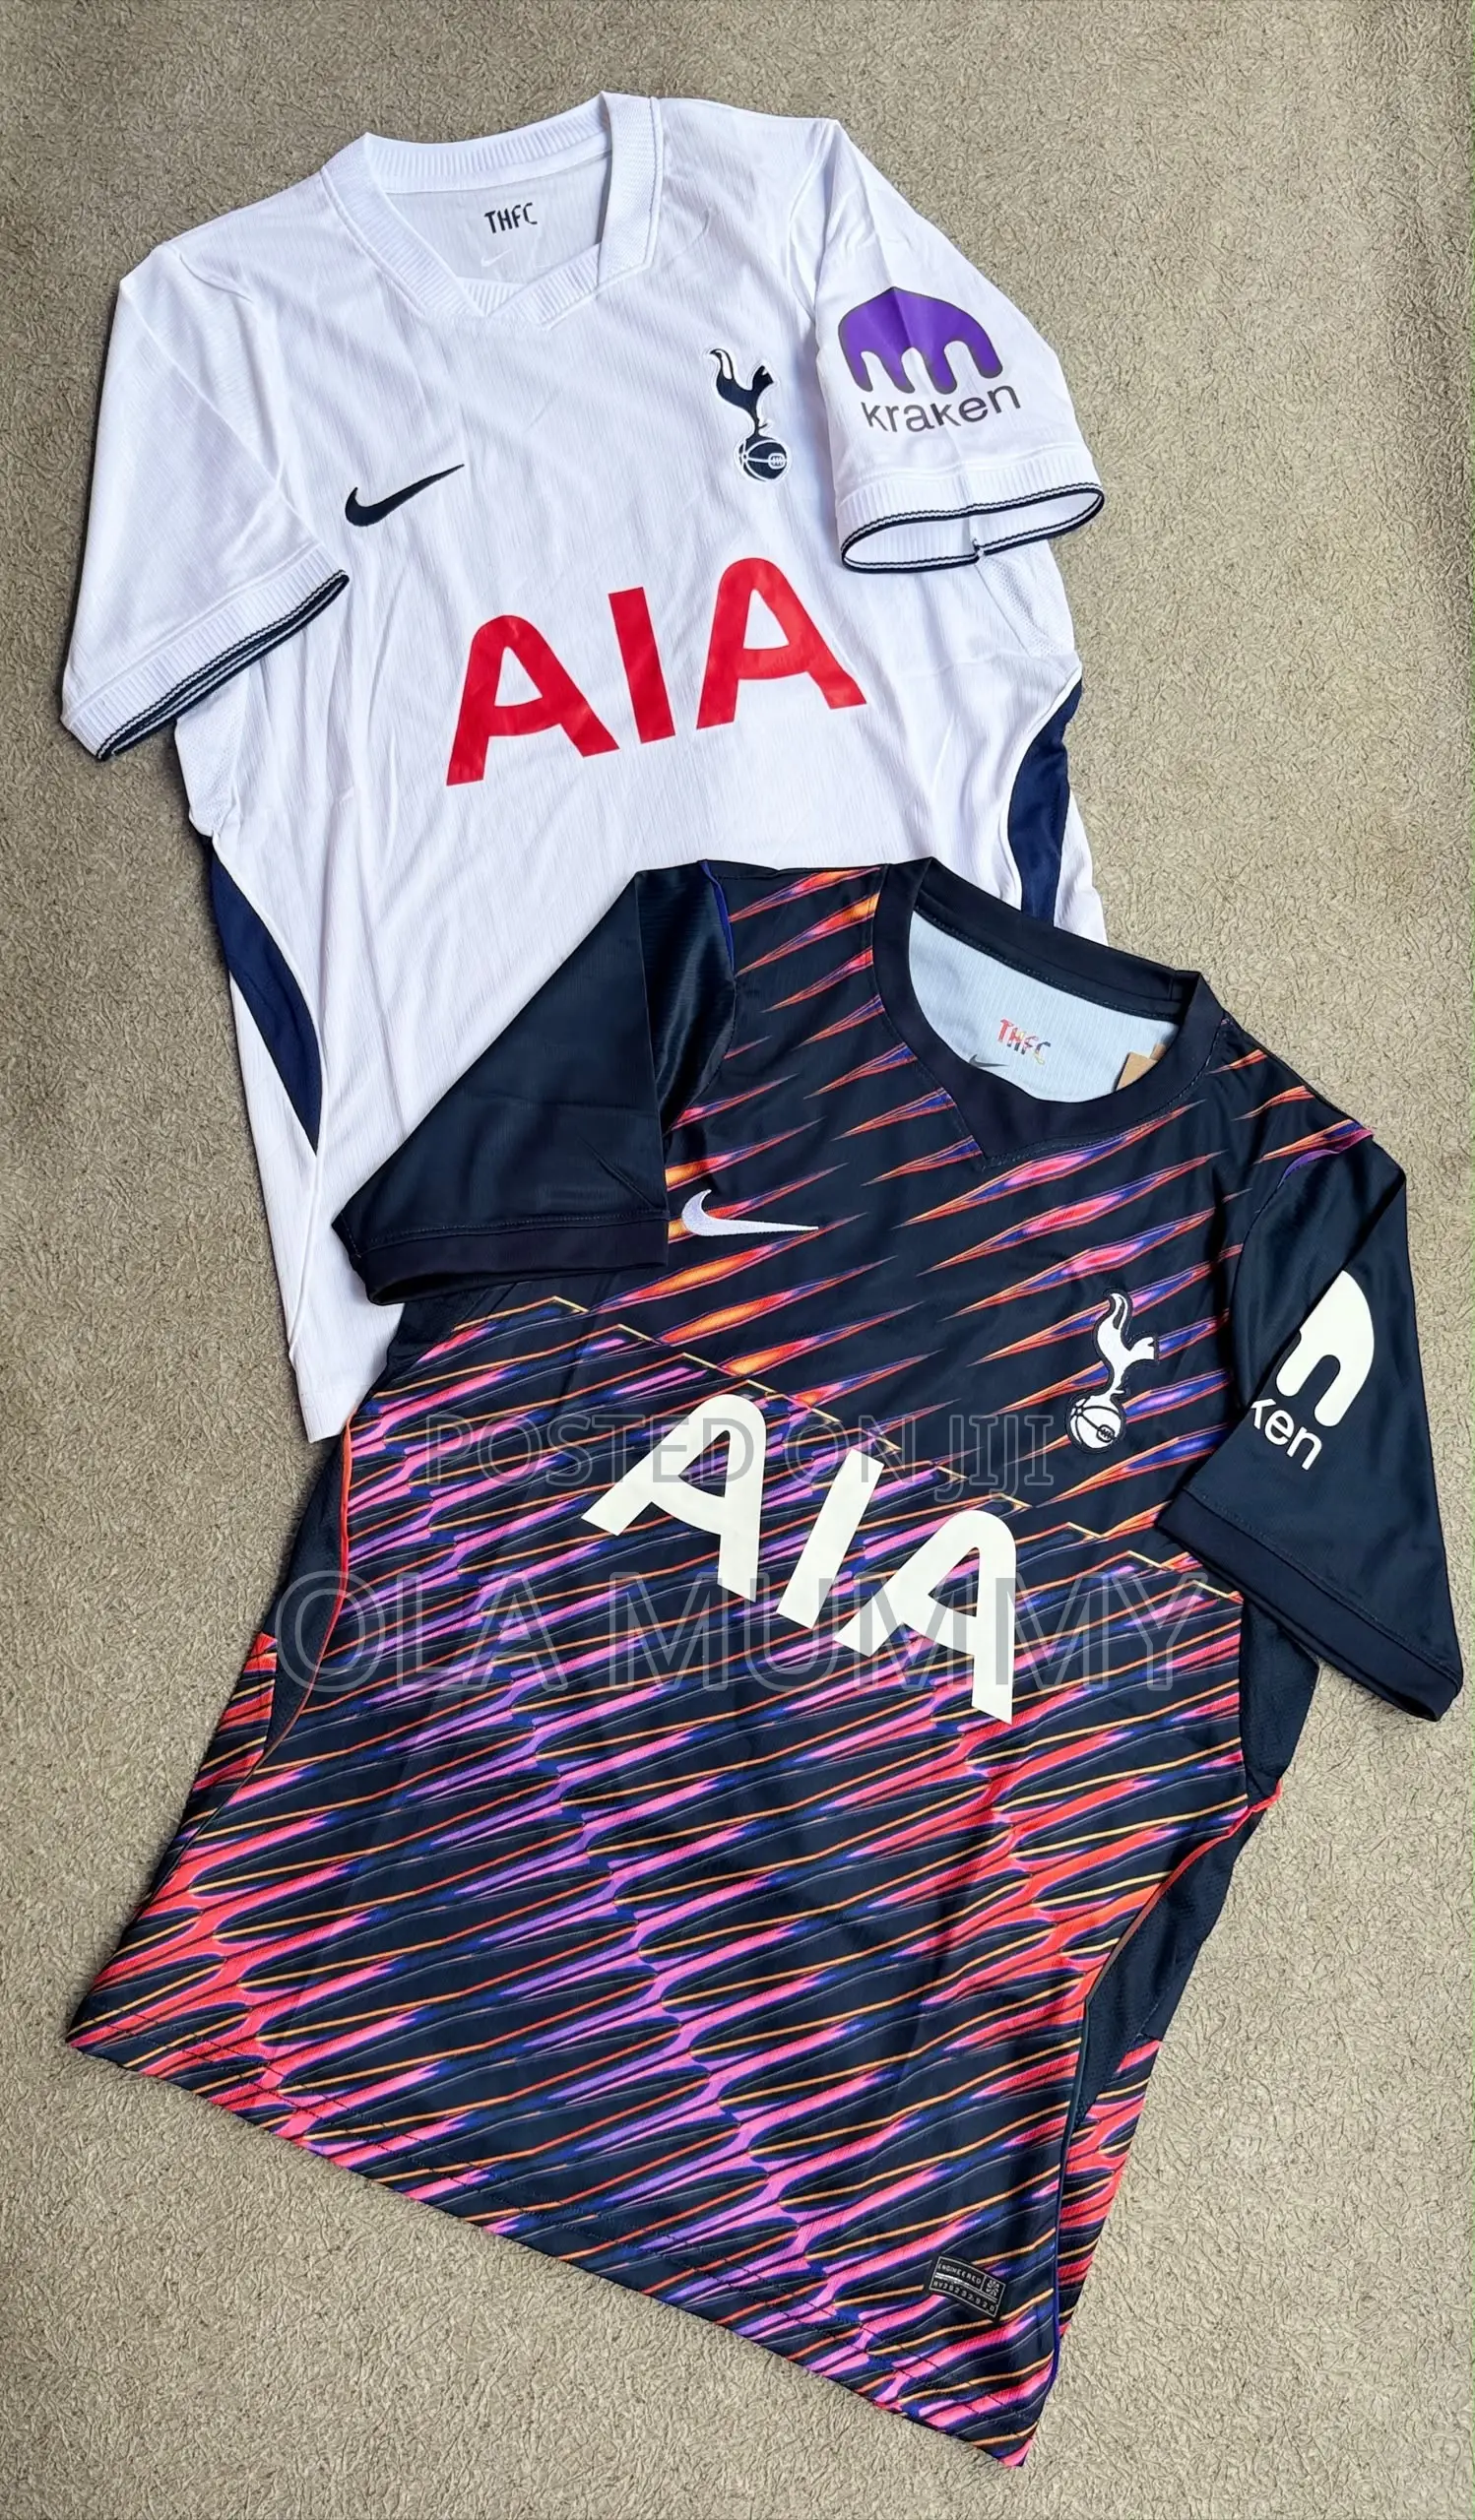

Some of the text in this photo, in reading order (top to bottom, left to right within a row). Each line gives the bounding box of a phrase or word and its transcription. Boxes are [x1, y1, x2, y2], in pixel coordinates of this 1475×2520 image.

[483, 202, 538, 233] THFC
[861, 384, 1021, 432] kraken
[446, 557, 867, 787] AIA
[999, 1018, 1052, 1065] THFC
[581, 1394, 1016, 1725] AIA
